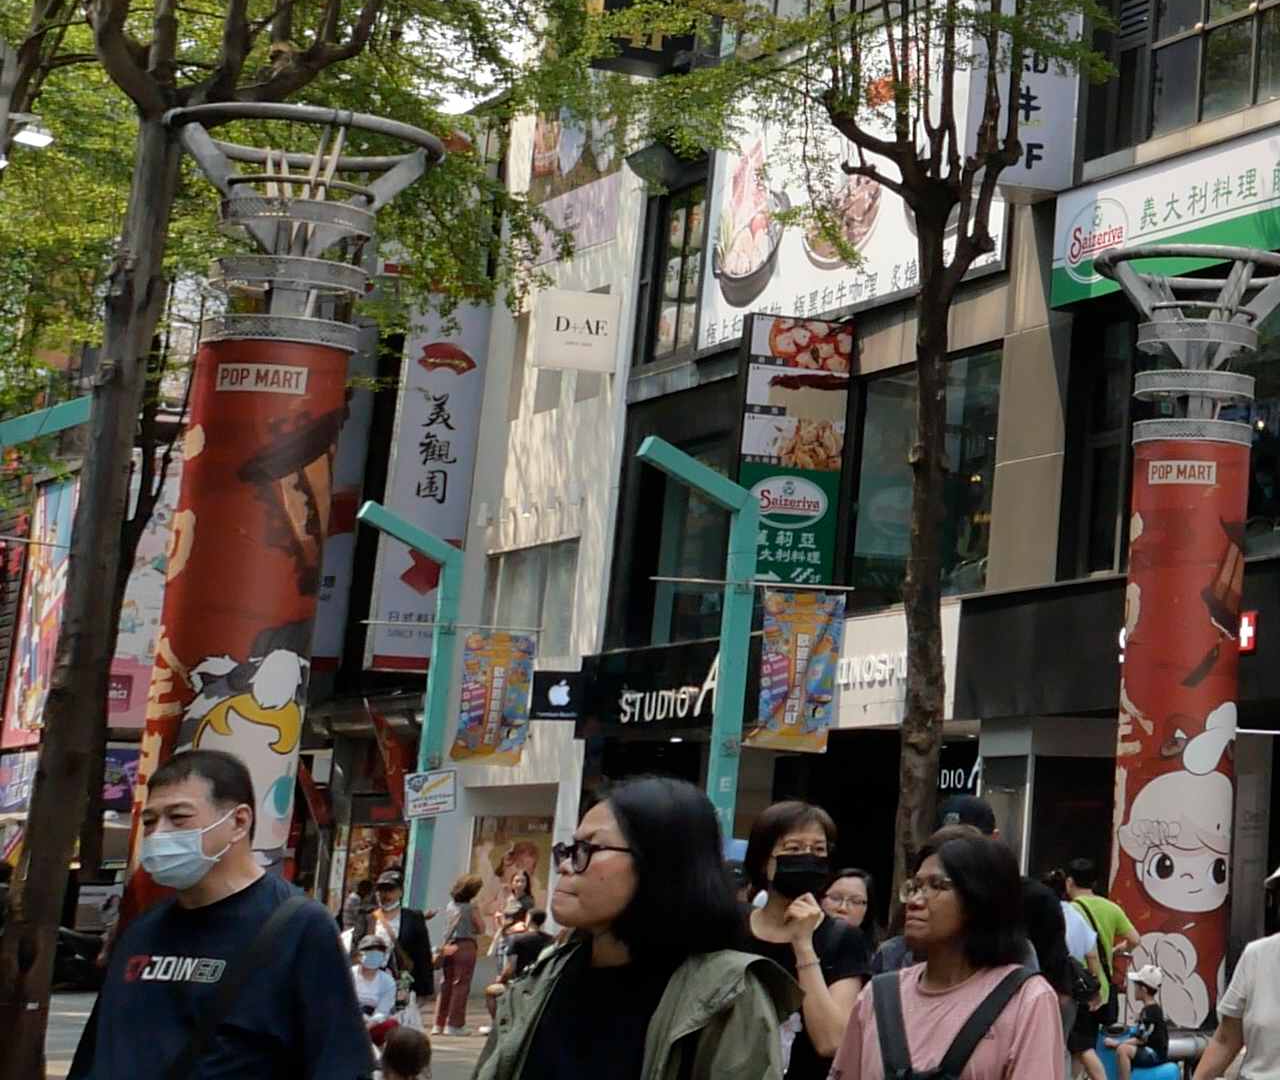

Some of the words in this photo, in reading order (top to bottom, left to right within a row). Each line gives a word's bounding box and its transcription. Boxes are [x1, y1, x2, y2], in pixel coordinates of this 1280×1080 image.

[1140, 167, 1259, 232] 義大利料理
[1069, 224, 1125, 265] Saizeriya
[219, 364, 251, 388] POP
[253, 367, 306, 392] MART
[1151, 463, 1173, 482] POP
[1176, 462, 1214, 482] MART
[619, 685, 688, 724] STUDIO
